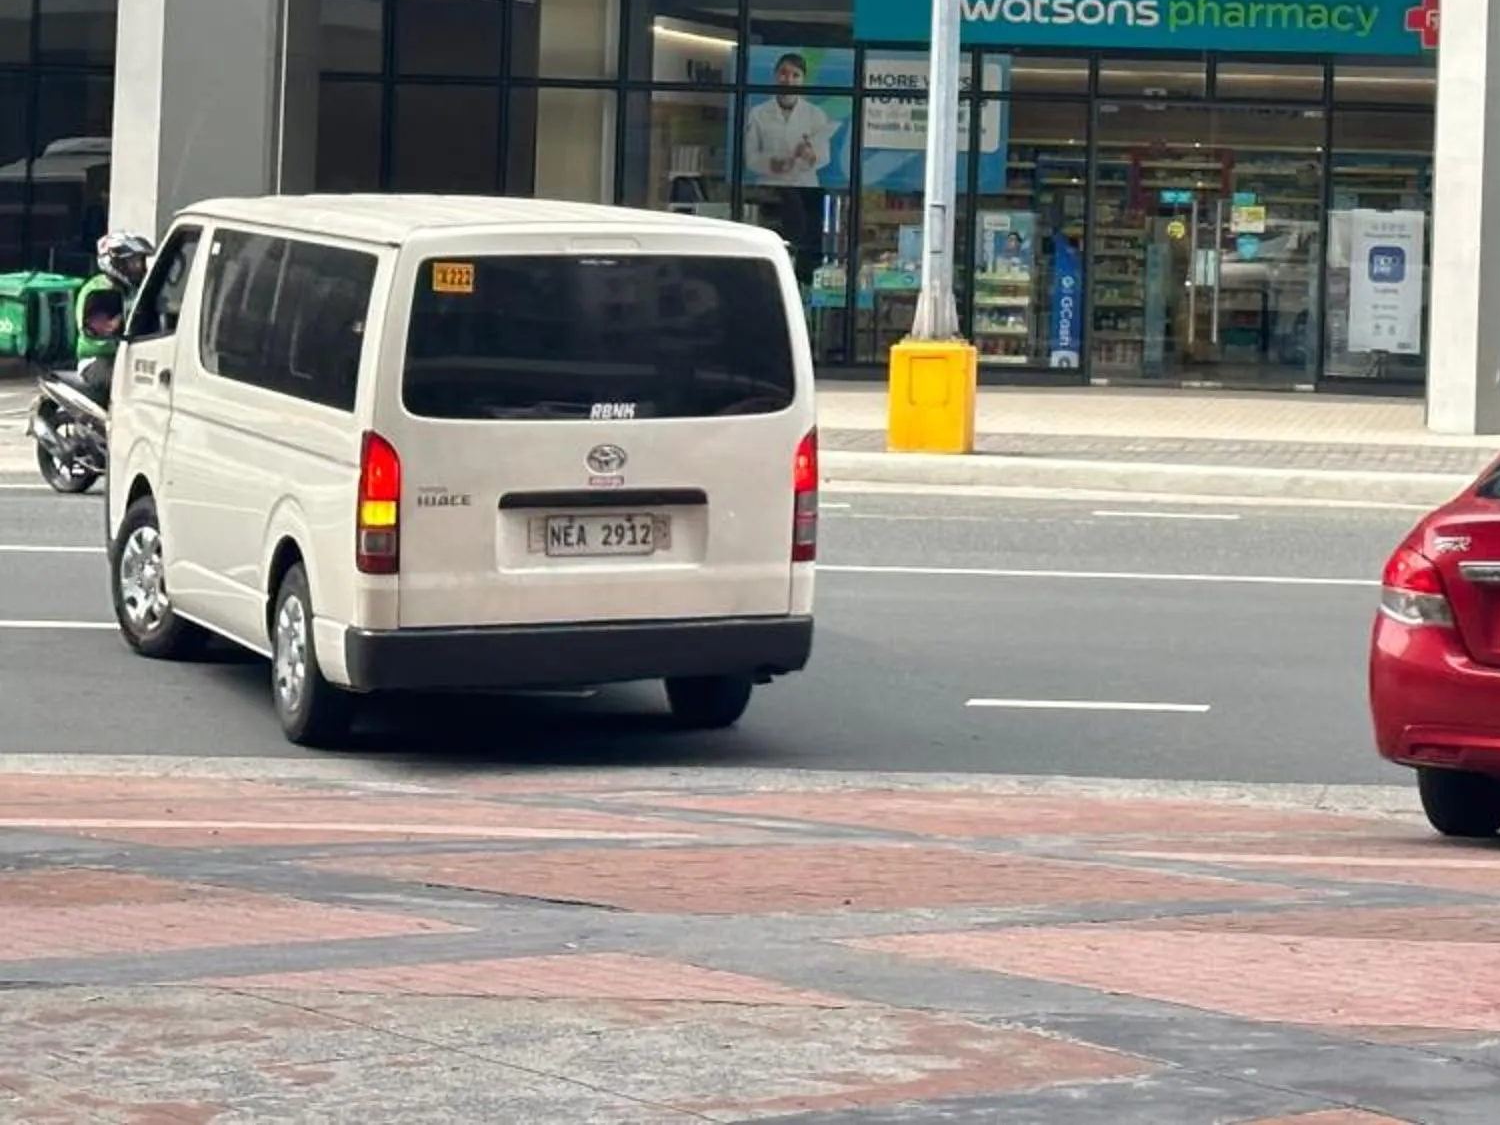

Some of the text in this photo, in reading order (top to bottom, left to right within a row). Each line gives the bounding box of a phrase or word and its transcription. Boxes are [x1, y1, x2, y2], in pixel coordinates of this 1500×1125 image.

[869, 74, 917, 87] MORE
[1059, 296, 1074, 346] GCash
[549, 521, 652, 547] NEA 2912
